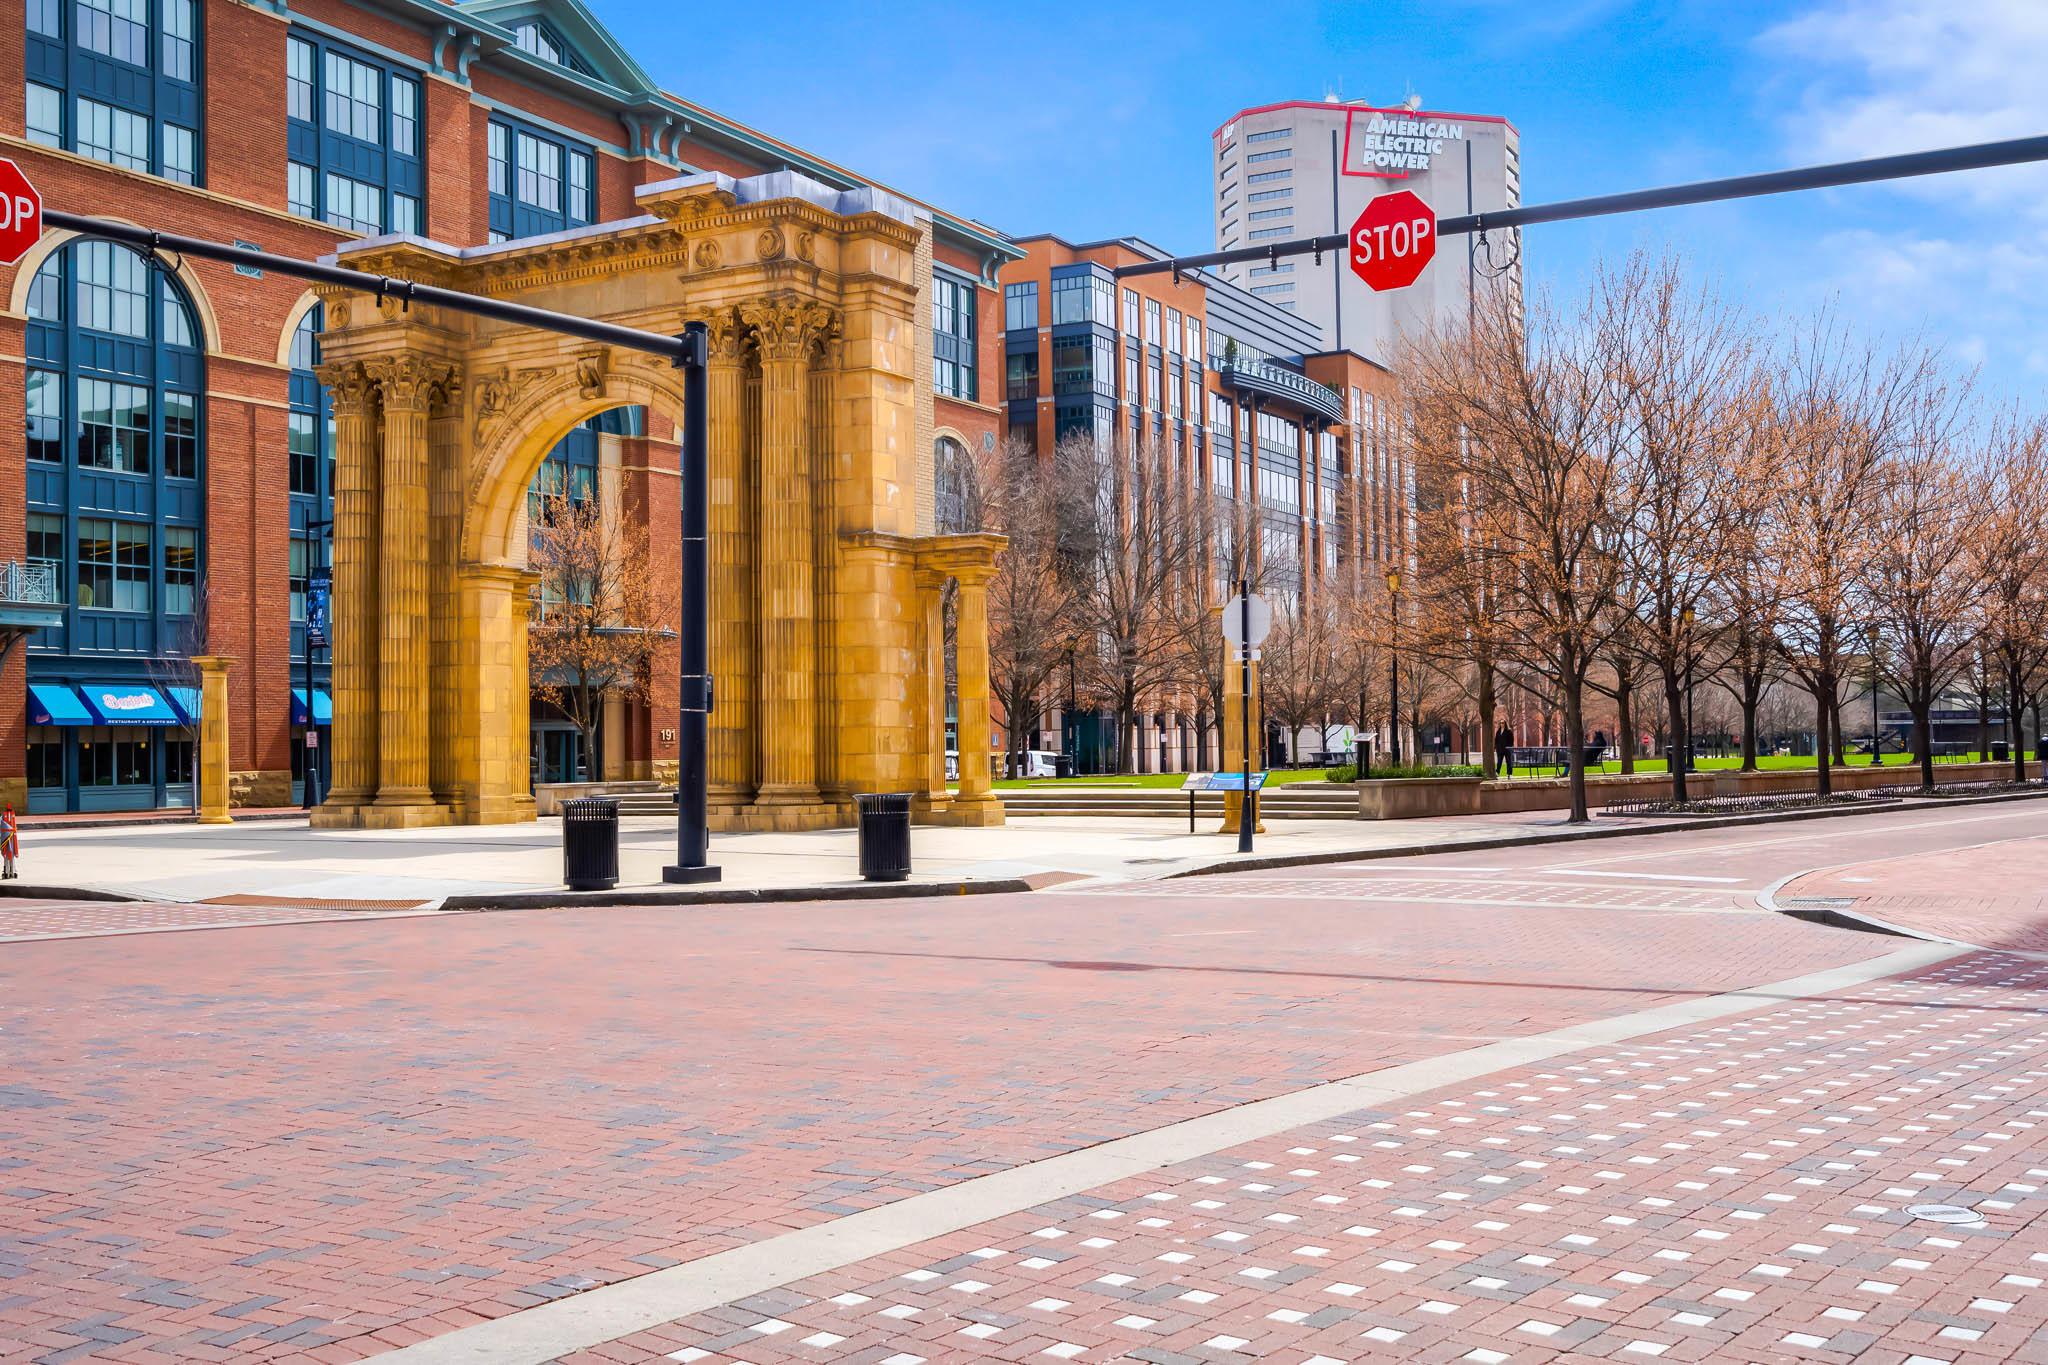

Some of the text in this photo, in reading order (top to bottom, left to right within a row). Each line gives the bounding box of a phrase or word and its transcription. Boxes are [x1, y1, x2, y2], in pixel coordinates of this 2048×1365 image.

[1366, 118, 1463, 140] AMERICAN
[1364, 134, 1443, 155] ELECTRIC
[1363, 151, 1429, 170] POWER
[0, 191, 35, 232] OP
[1355, 218, 1430, 264] STOP
[660, 728, 676, 741] 191
